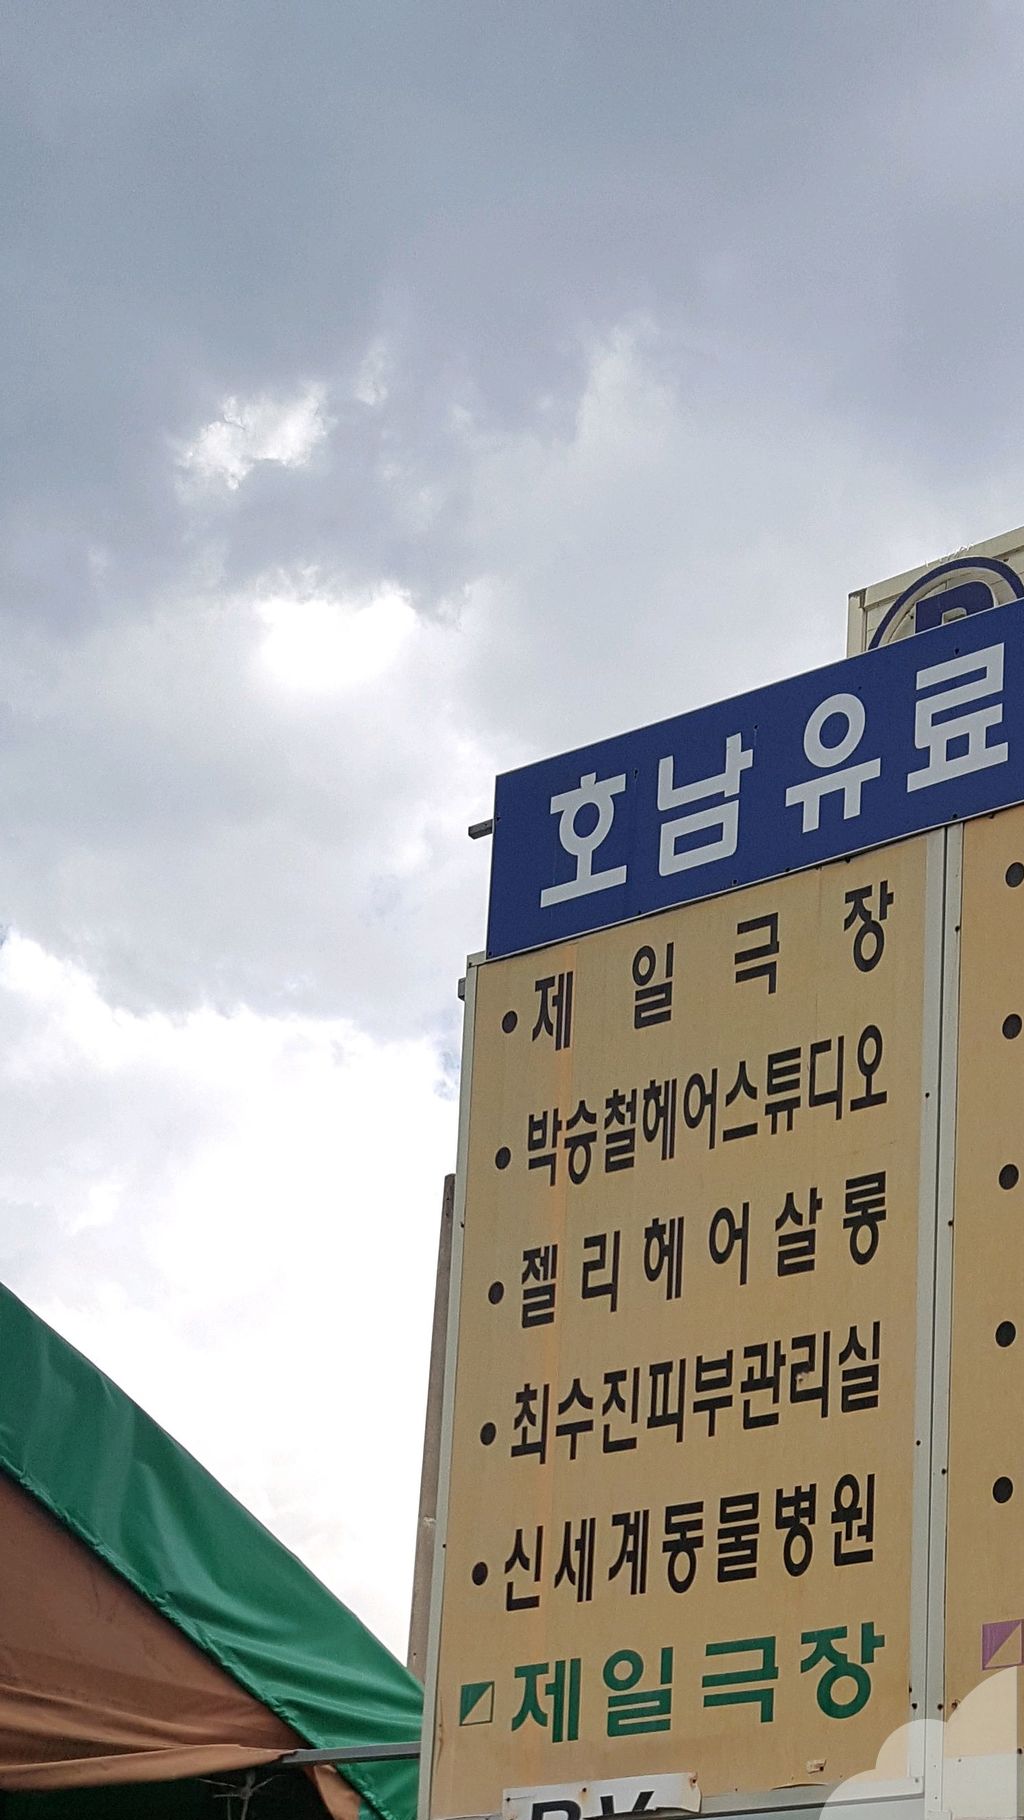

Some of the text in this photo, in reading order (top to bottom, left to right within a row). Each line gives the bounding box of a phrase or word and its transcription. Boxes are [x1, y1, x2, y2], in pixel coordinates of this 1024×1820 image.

[528, 1025, 887, 1186] 박승철헤어스튜디오
[511, 1321, 880, 1464] 최수진피부관리실
[505, 1474, 875, 1611] 신세계동물병원
[510, 1625, 885, 1744] 제일극장
